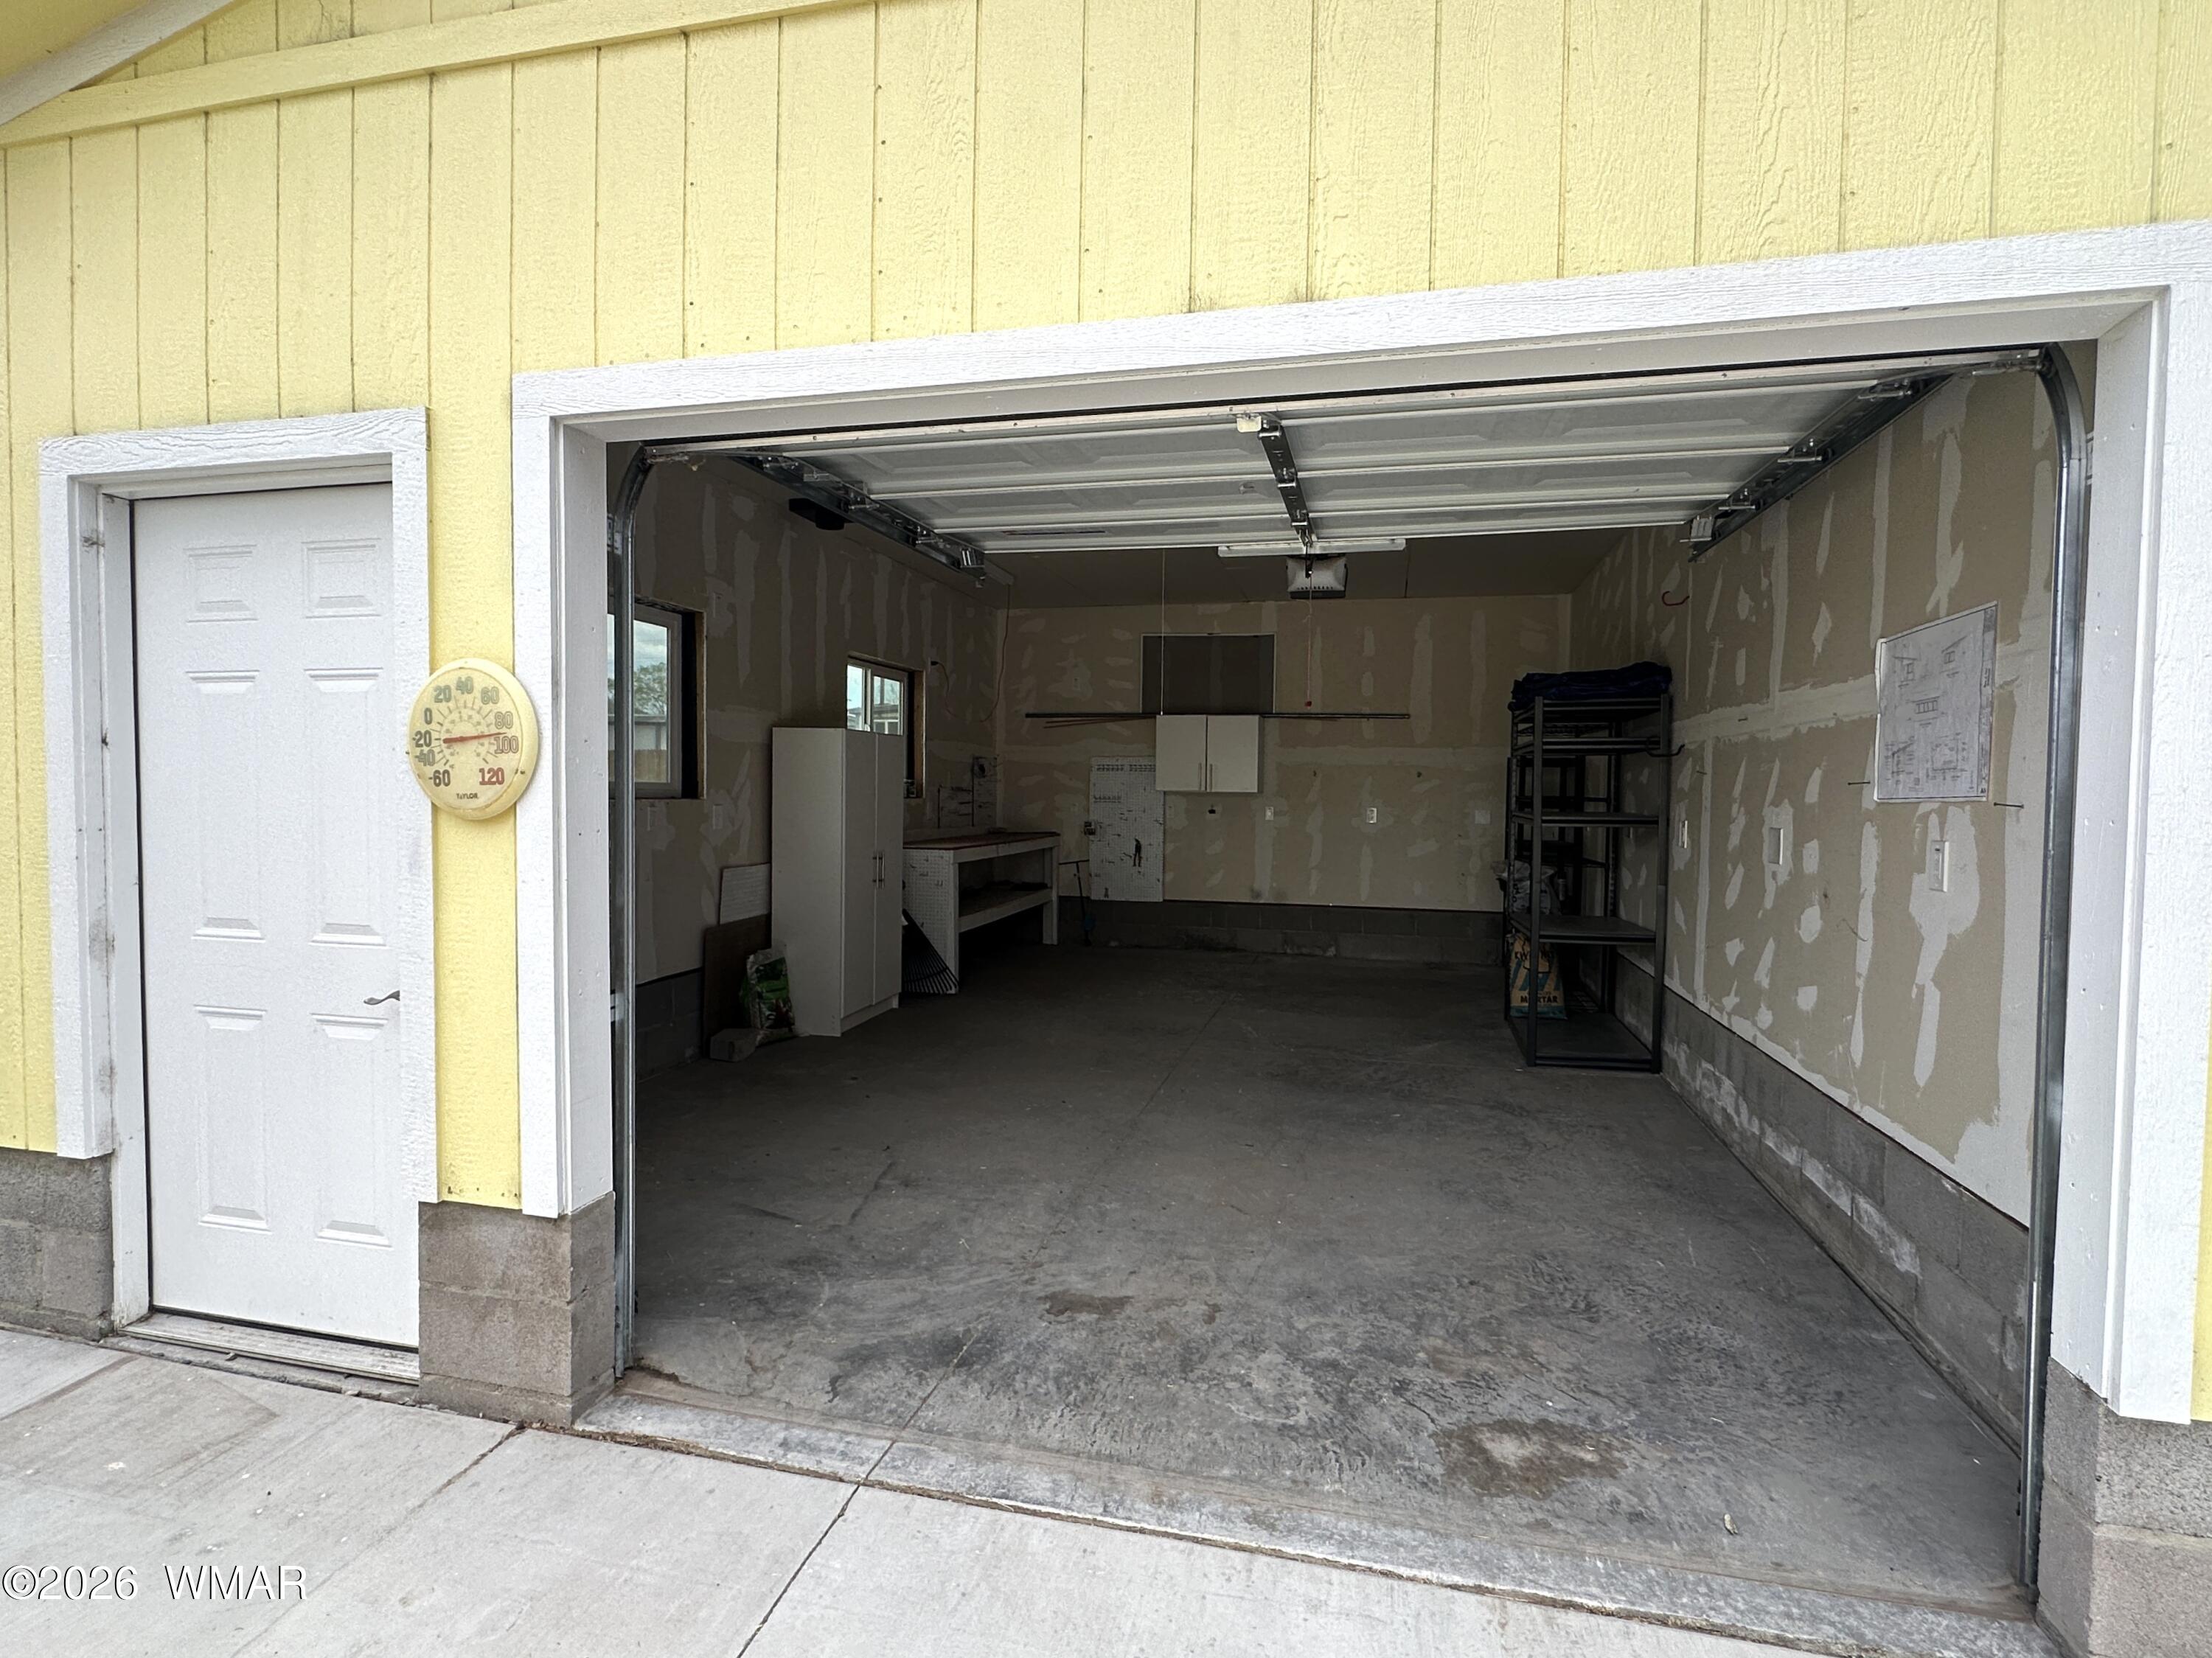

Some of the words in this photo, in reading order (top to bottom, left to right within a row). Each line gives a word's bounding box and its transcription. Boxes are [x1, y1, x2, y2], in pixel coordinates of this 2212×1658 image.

[434, 685, 451, 703] 20
[456, 676, 473, 694] 40
[481, 686, 500, 705] 60
[424, 708, 433, 725] 0
[495, 711, 513, 729] 80
[494, 736, 519, 754] 100
[428, 769, 451, 787] -60
[479, 767, 504, 785] 120
